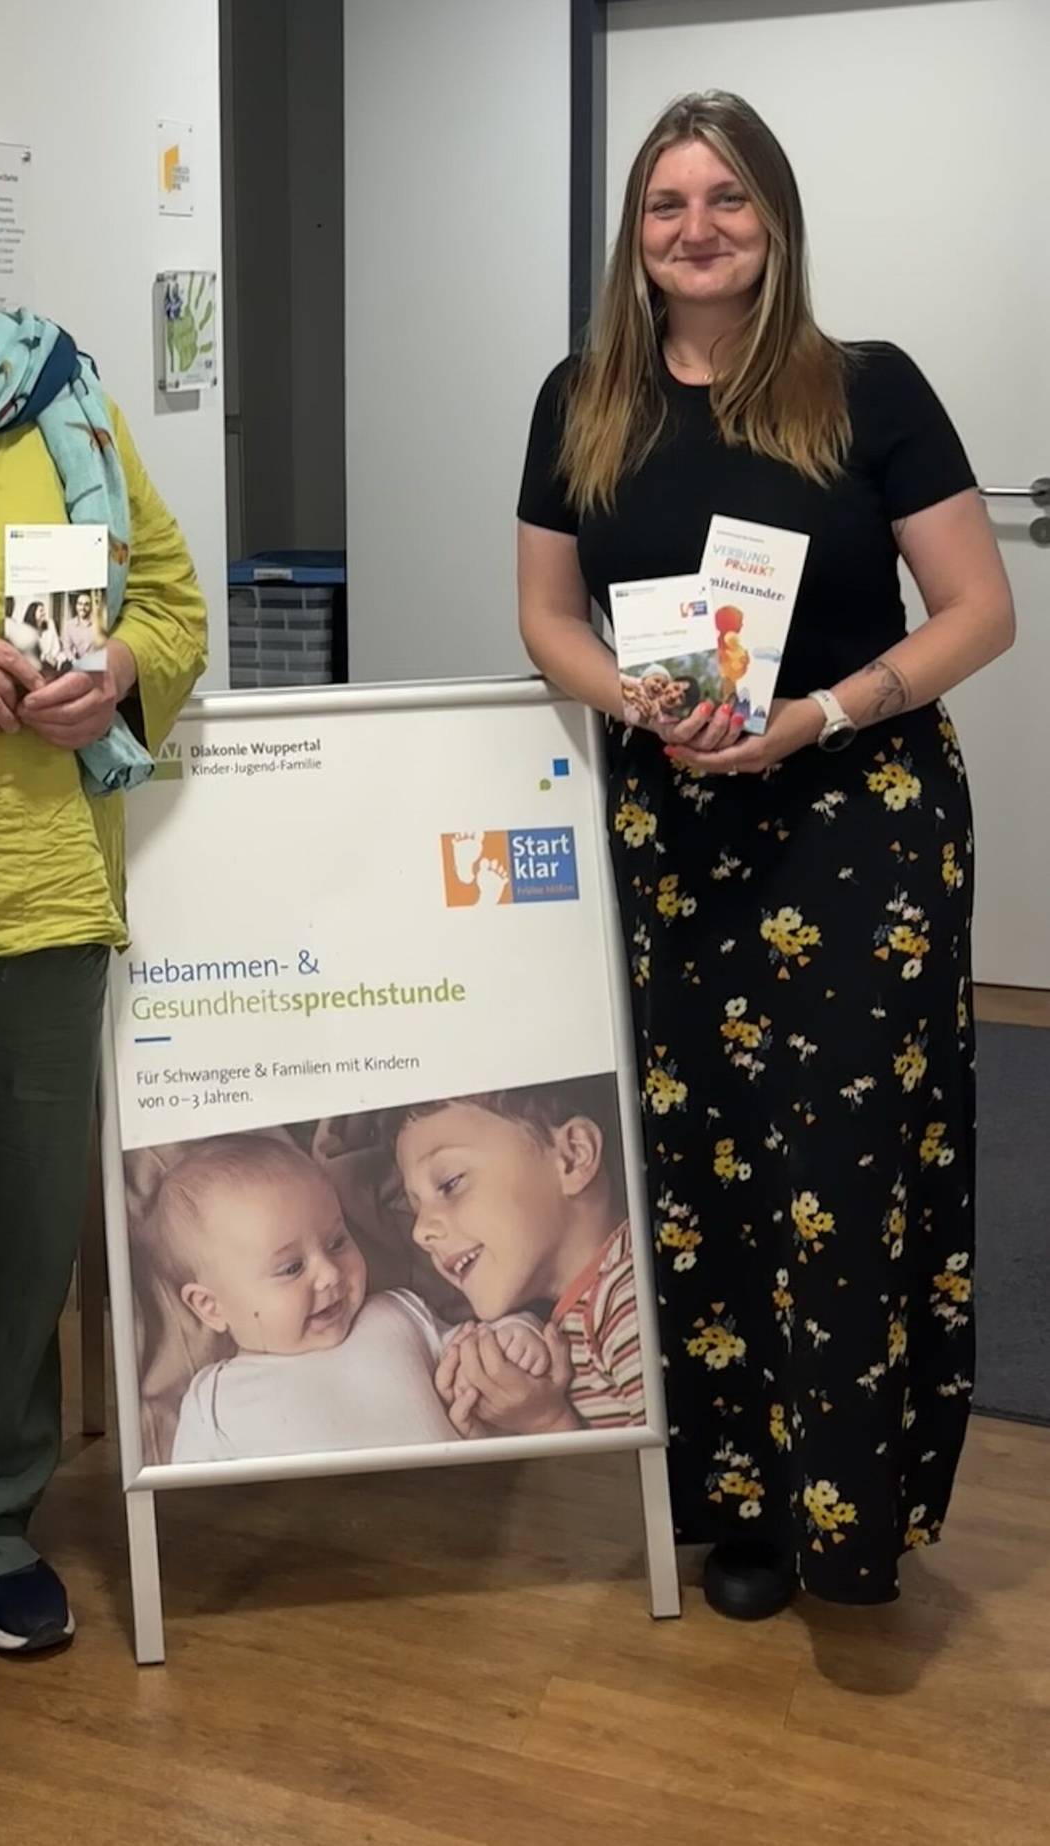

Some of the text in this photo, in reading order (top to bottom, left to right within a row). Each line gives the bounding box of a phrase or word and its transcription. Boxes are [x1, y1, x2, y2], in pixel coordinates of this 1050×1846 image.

[725, 557, 776, 577] PROJEKT
[190, 738, 321, 758] Diakonie Wuppertal
[512, 833, 571, 857] Start
[514, 857, 560, 879] klar
[128, 950, 321, 985] Hebammen- &
[131, 977, 466, 1021] Gesundheitssprechstunde
[136, 1054, 420, 1086] Für Schwangere & Familien mit Kindern
[137, 1095, 165, 1109] von
[202, 1088, 254, 1106] Jahren.
